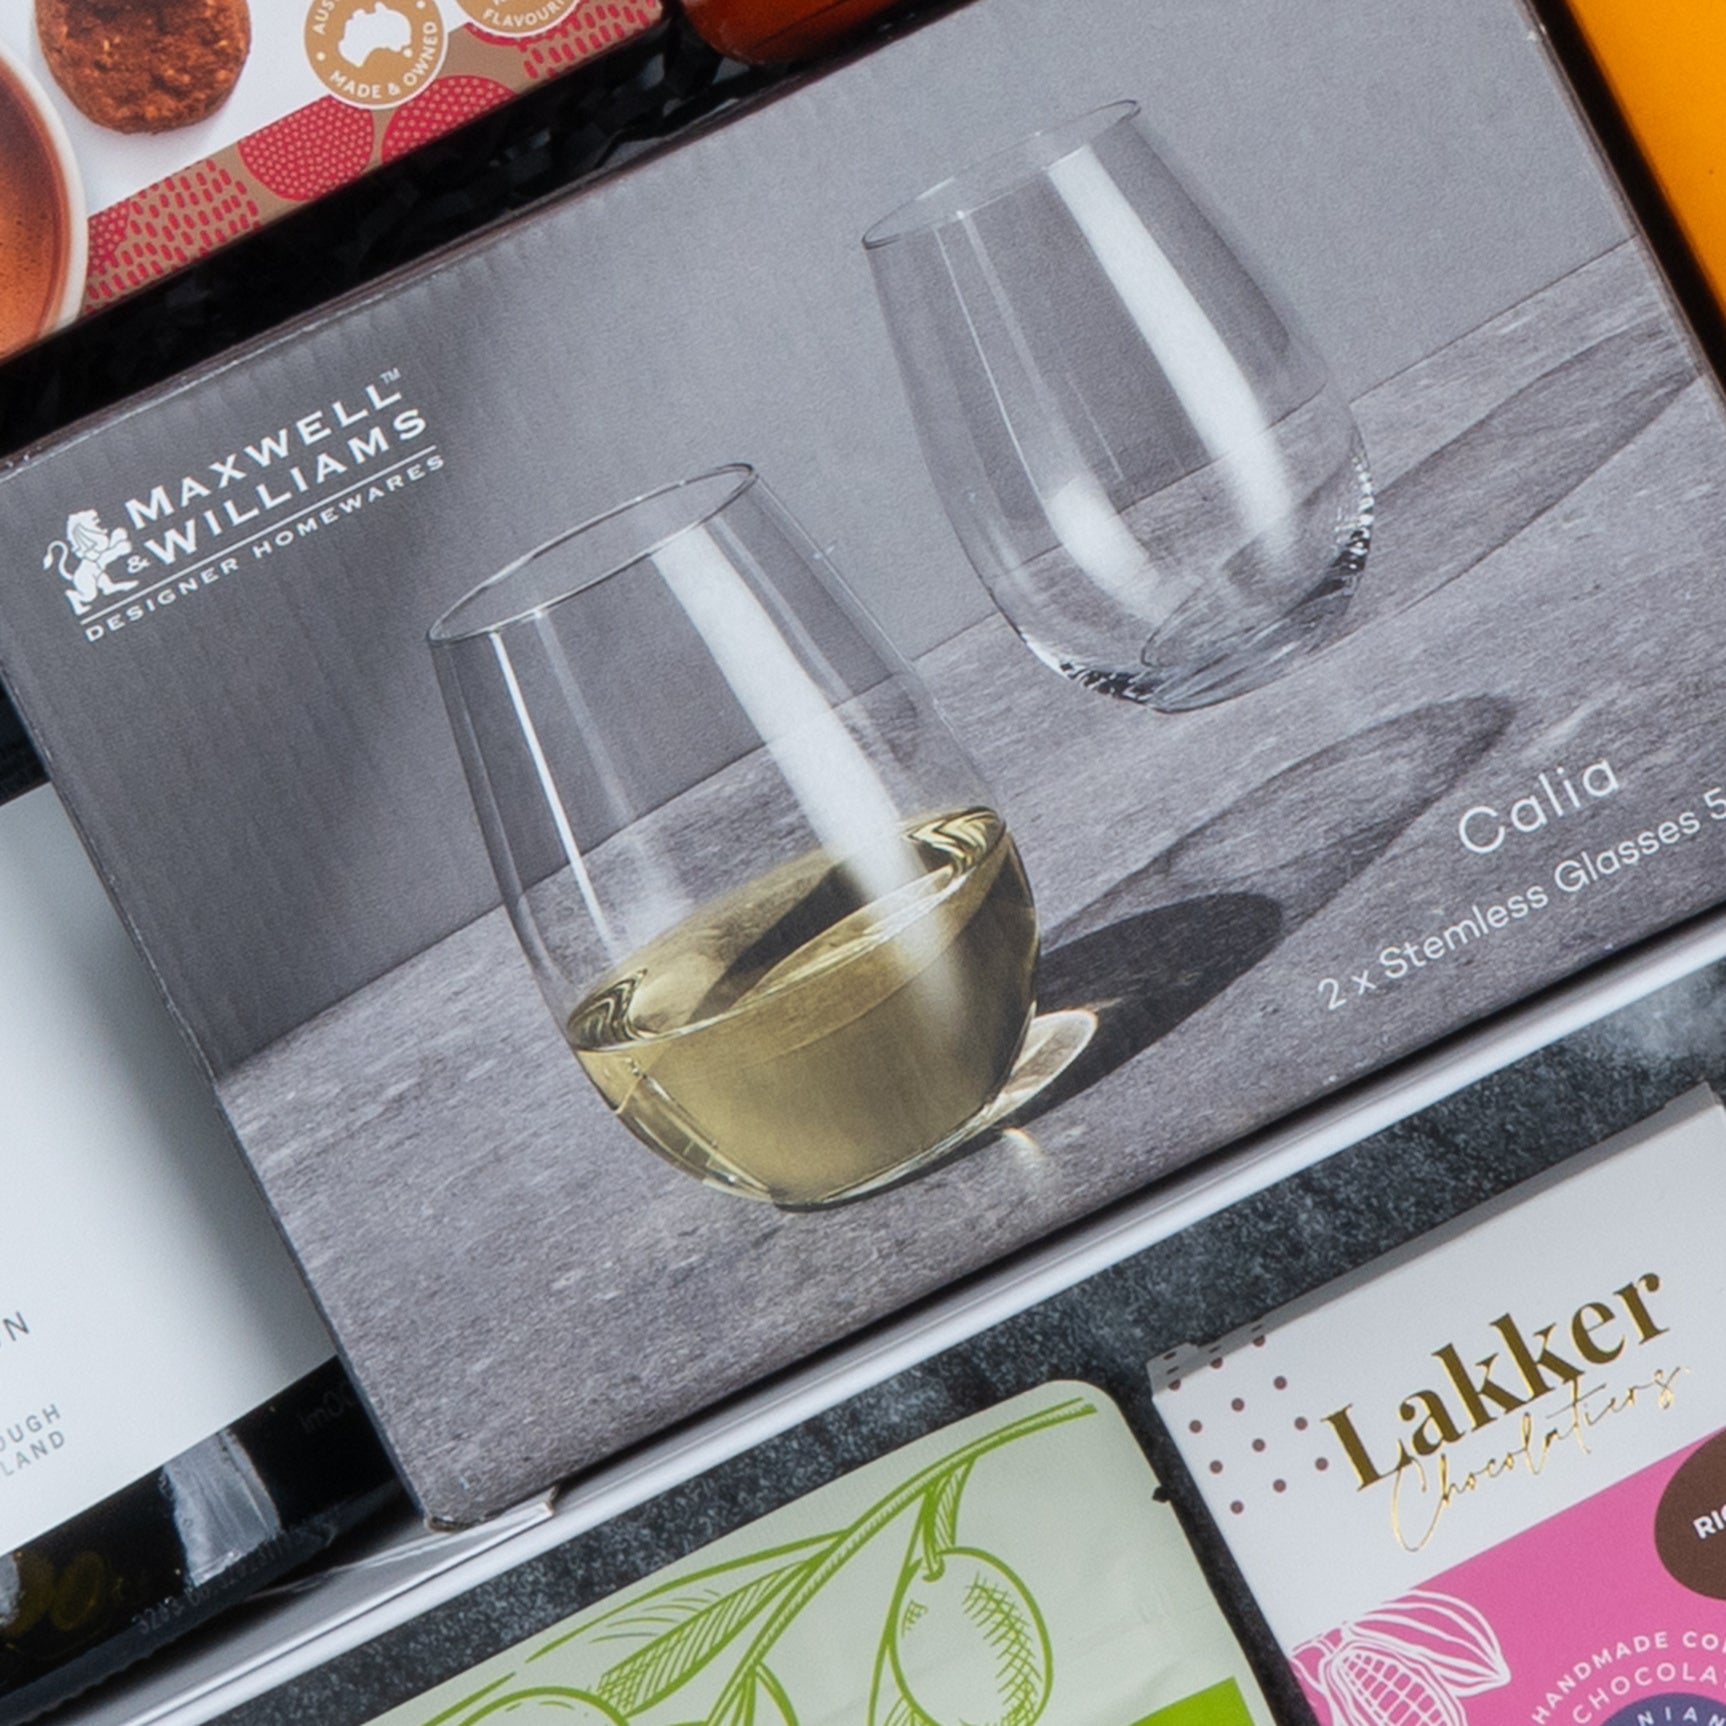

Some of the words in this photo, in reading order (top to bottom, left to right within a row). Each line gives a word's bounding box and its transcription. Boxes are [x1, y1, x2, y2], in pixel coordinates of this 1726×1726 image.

[312, 0, 341, 35] AUS
[330, 70, 382, 99] MADE
[387, 83, 401, 96] &
[403, 21, 438, 86] OWNED
[125, 383, 402, 529] MAXWELL
[85, 557, 239, 643] DESIGNER
[252, 454, 446, 560] HOMEWARES
[1458, 758, 1620, 854] Calia
[1317, 979, 1347, 1011] 2
[1352, 969, 1377, 995] x
[1380, 884, 1549, 978] Stemless
[1554, 810, 1701, 893] Glasses
[1321, 1271, 1670, 1493] Lakker
[1390, 1364, 1692, 1552] Chocolatiers
[1531, 1632, 1668, 1725] HANDMADE
[1682, 1630, 1726, 1654] CO
[1572, 1662, 1726, 1724] CHOCOLA
